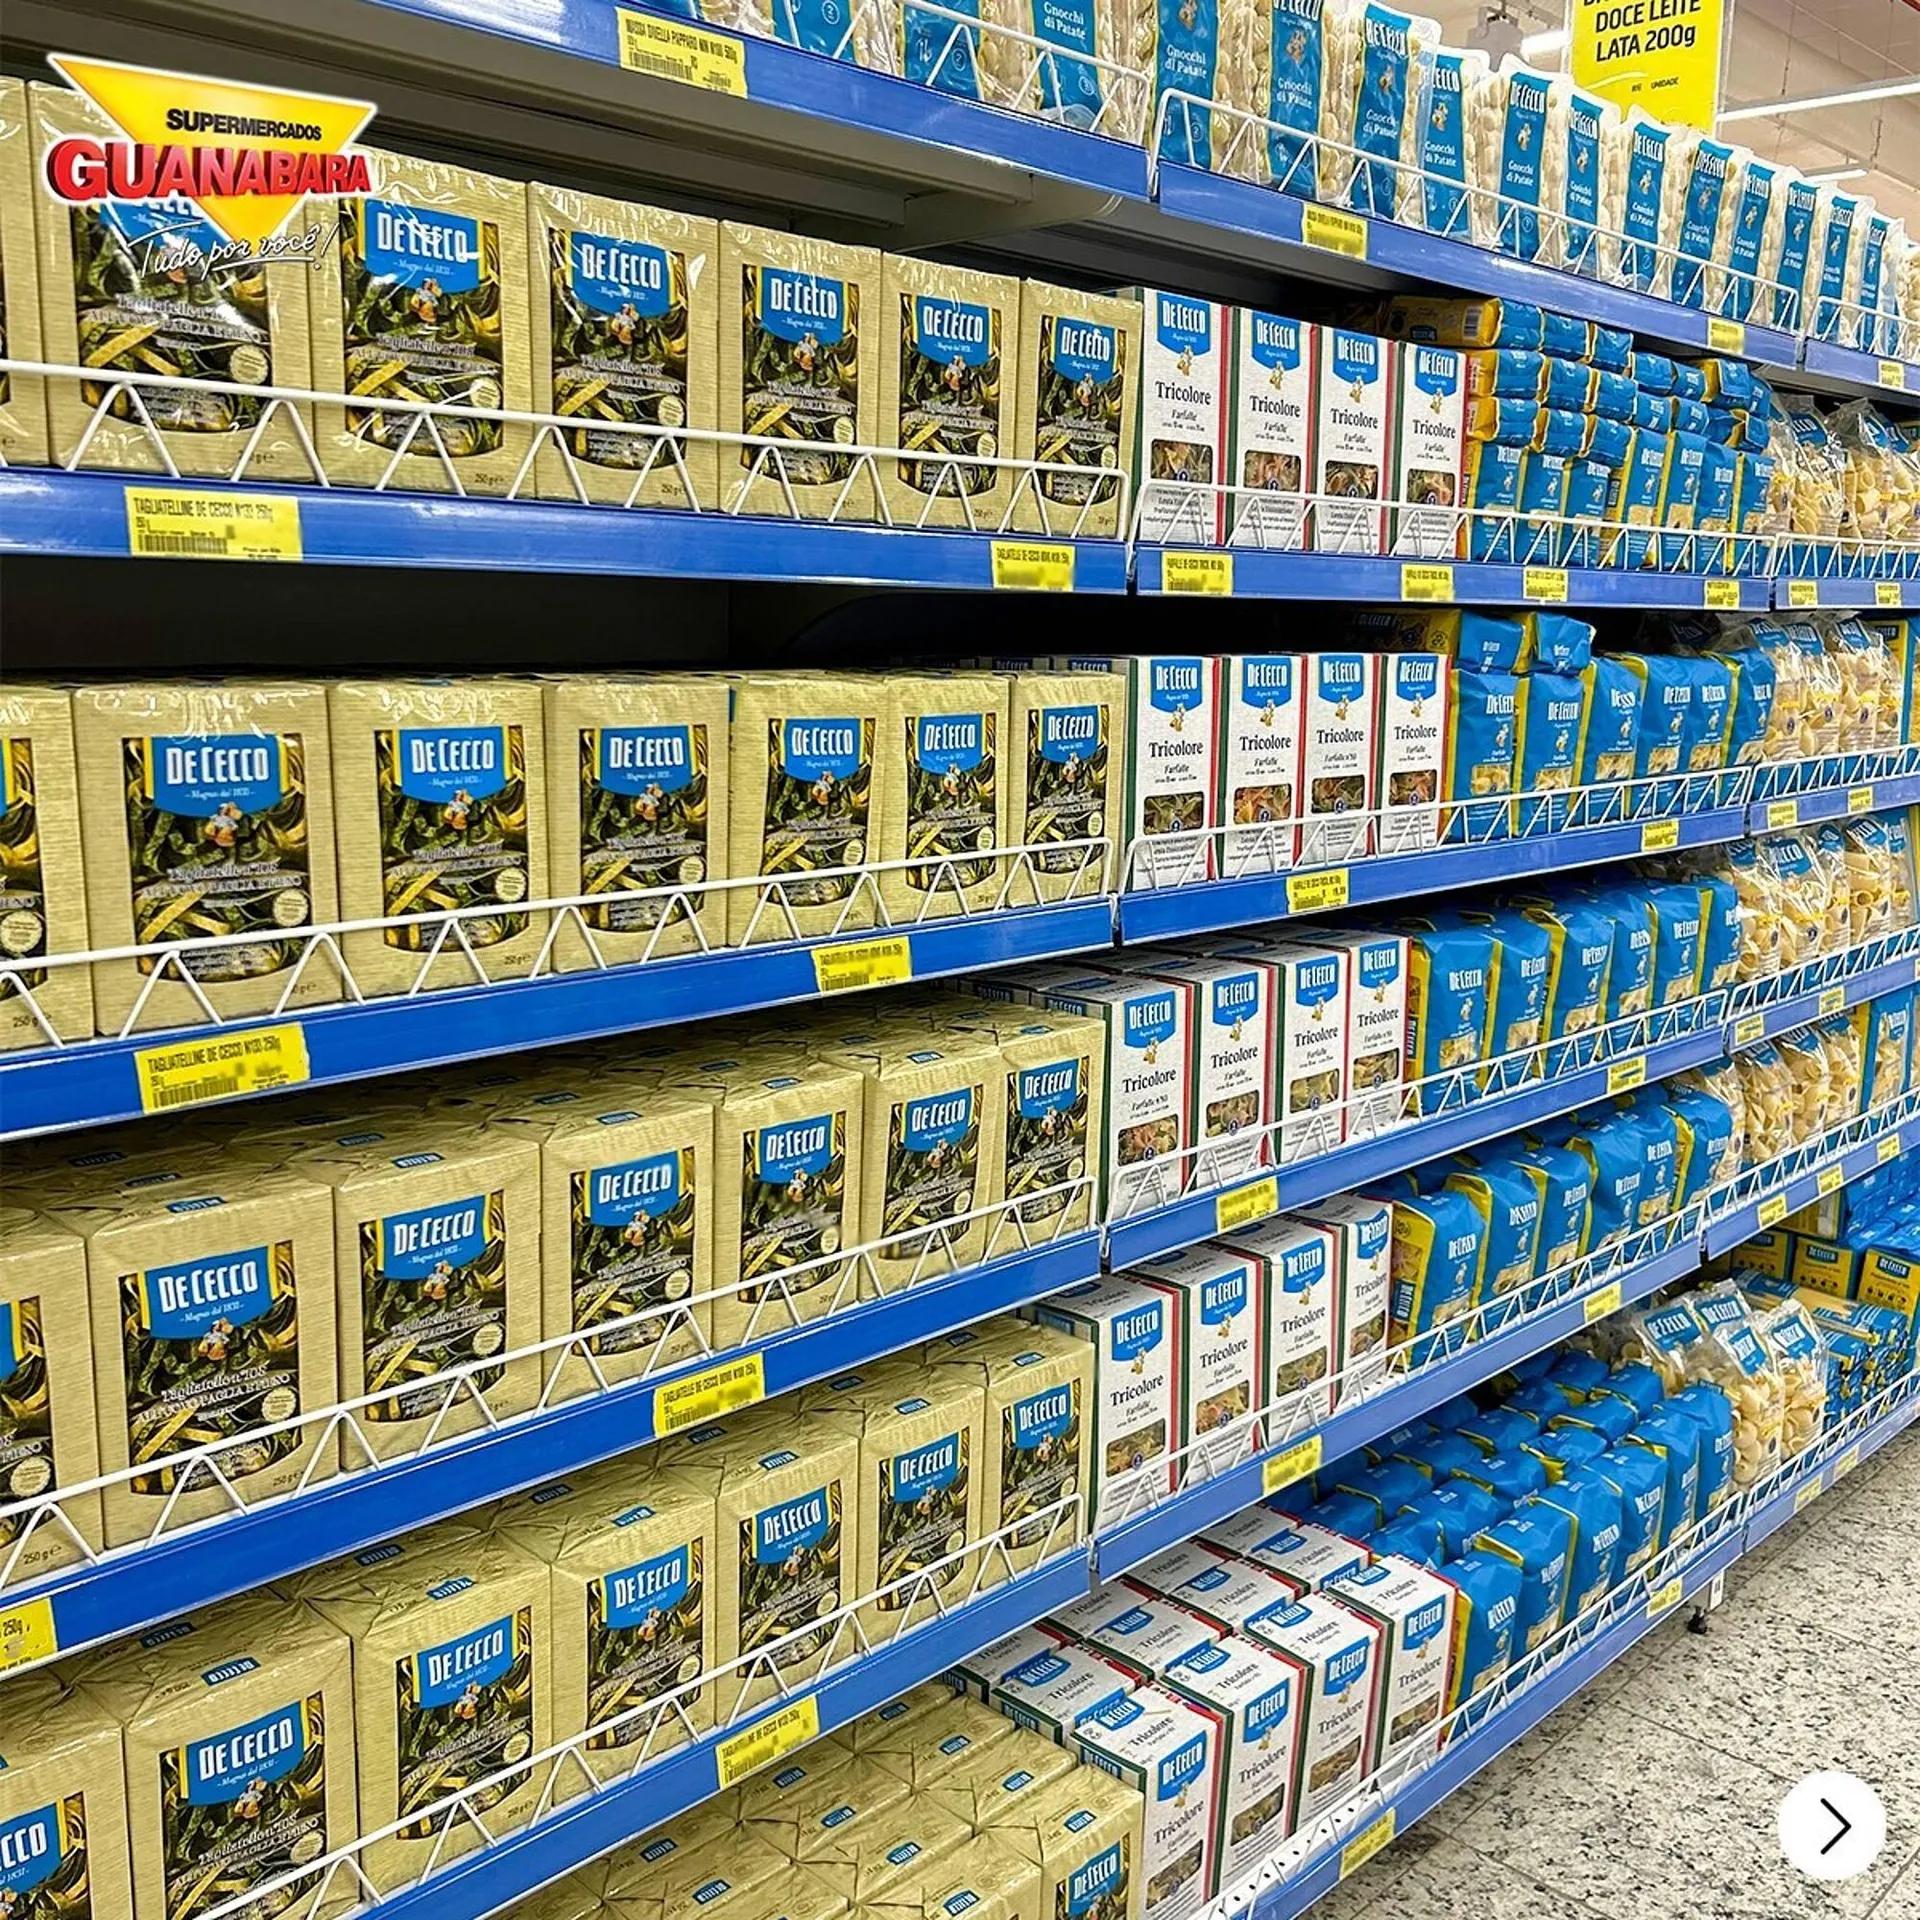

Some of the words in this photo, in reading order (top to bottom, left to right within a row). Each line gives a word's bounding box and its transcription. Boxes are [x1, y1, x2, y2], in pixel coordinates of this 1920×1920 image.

[1043, 1, 1085, 25] Gnocchi
[1596, 3, 1645, 33] DOCE
[1056, 20, 1087, 40] Patate
[1596, 34, 1641, 62] LATA
[1645, 24, 1696, 52] 200g
[1166, 44, 1206, 65] Gnocchi
[1177, 62, 1207, 79] Patate
[1277, 77, 1312, 94] Gnocchi
[1651, 77, 1679, 90] UNIDADE
[579, 244, 606, 280] DE
[608, 248, 661, 289] CECCO
[771, 278, 792, 312] DE
[794, 279, 837, 319] CECCO
[923, 306, 942, 337] DE
[943, 309, 983, 343] CECCO
[1163, 300, 1176, 328] DE
[1177, 304, 1205, 334] CECCO
[1155, 381, 1211, 406] Tricolore
[1250, 396, 1300, 418] Tricolore
[1331, 408, 1378, 429] Tricolore
[1412, 418, 1456, 439] Tricolore
[134, 497, 194, 517] TAGLIATELLINE
[195, 501, 207, 517] DE
[209, 502, 233, 518] CECCO
[1156, 666, 1169, 690] DE
[1169, 665, 1197, 690] CECCO
[1248, 664, 1260, 687] DE
[1260, 664, 1287, 687] CECCO
[792, 728, 810, 756] DE
[812, 728, 853, 755] CECCO
[924, 724, 941, 751] DE
[942, 723, 975, 749] CECCO
[1240, 734, 1291, 752] Tricolore
[1316, 728, 1364, 745] Tricolore
[1394, 724, 1437, 741] Tricolore
[411, 739, 437, 773] DE
[438, 739, 494, 771] CECCO
[610, 737, 633, 768] DE
[635, 737, 684, 767] CECCO
[1149, 741, 1203, 758] Tricolore
[166, 748, 197, 784] DE
[201, 747, 269, 783] CECCO
[1300, 968, 1311, 989] DE
[1312, 964, 1335, 987] CECCO
[1217, 986, 1229, 1008] DE
[1230, 981, 1255, 1005] CECCO
[1129, 1006, 1142, 1029] DE
[1143, 1000, 1171, 1026] CECCO
[1357, 1008, 1399, 1028] Tricolore
[1293, 1025, 1338, 1048] Tricolore
[148, 1049, 206, 1073] TAGLIATELLINE
[208, 1046, 218, 1062] DE
[219, 1042, 243, 1060] CECCO
[1211, 1045, 1258, 1069] Tricolore
[1025, 1076, 1041, 1099] DE
[1041, 1069, 1073, 1096] CECCO
[1122, 1068, 1176, 1093] Tricolore
[912, 1107, 930, 1132] DE
[930, 1099, 966, 1128] CECCO
[766, 1134, 785, 1162] DE
[786, 1126, 825, 1157] CECCO
[599, 1175, 621, 1203] DE
[622, 1164, 671, 1198] CECCO
[394, 1224, 419, 1256] DE
[421, 1210, 475, 1248] CECCO
[1287, 1256, 1299, 1277] DE
[1298, 1247, 1325, 1273] CECCO
[158, 1276, 189, 1312] DE
[191, 1261, 258, 1304] CECCO
[1206, 1282, 1217, 1308] DE
[1218, 1277, 1243, 1304] CECCO
[1354, 1272, 1387, 1298] Tricolore
[1117, 1316, 1131, 1343] DE
[1131, 1310, 1158, 1339] CECCO
[1280, 1306, 1326, 1334] Tricolore
[1199, 1338, 1248, 1369] Tricolore
[1109, 1373, 1164, 1407] Tricolore
[1019, 1406, 1033, 1431] DE
[1034, 1394, 1066, 1424] CECCO
[900, 1459, 917, 1484] DE
[918, 1444, 952, 1477] CECCO
[272, 1476, 287, 1486] 250
[614, 1577, 636, 1608] DE
[637, 1558, 680, 1599] CECCO
[3, 1619, 24, 1639] 250g
[1407, 1613, 1418, 1636] DE
[1419, 1603, 1445, 1630] CECCO
[428, 1653, 452, 1687] DE
[455, 1629, 503, 1674] CECCO
[1329, 1656, 1340, 1679] DE
[1341, 1646, 1369, 1675] CECCO
[1397, 1656, 1442, 1686] Tricolore
[1248, 1704, 1260, 1727] DE
[1260, 1688, 1285, 1720] CECCO
[1318, 1700, 1364, 1734] Tricolore
[199, 1744, 227, 1780] DE
[231, 1718, 293, 1768] CECCO
[1159, 1757, 1175, 1785] DE
[1176, 1742, 1206, 1776] CECCO
[1238, 1745, 1286, 1787] Tricolore
[1153, 1801, 1204, 1844] Tricolore
[1073, 1869, 1088, 1899] DE
[1090, 1853, 1118, 1892] CECCO
